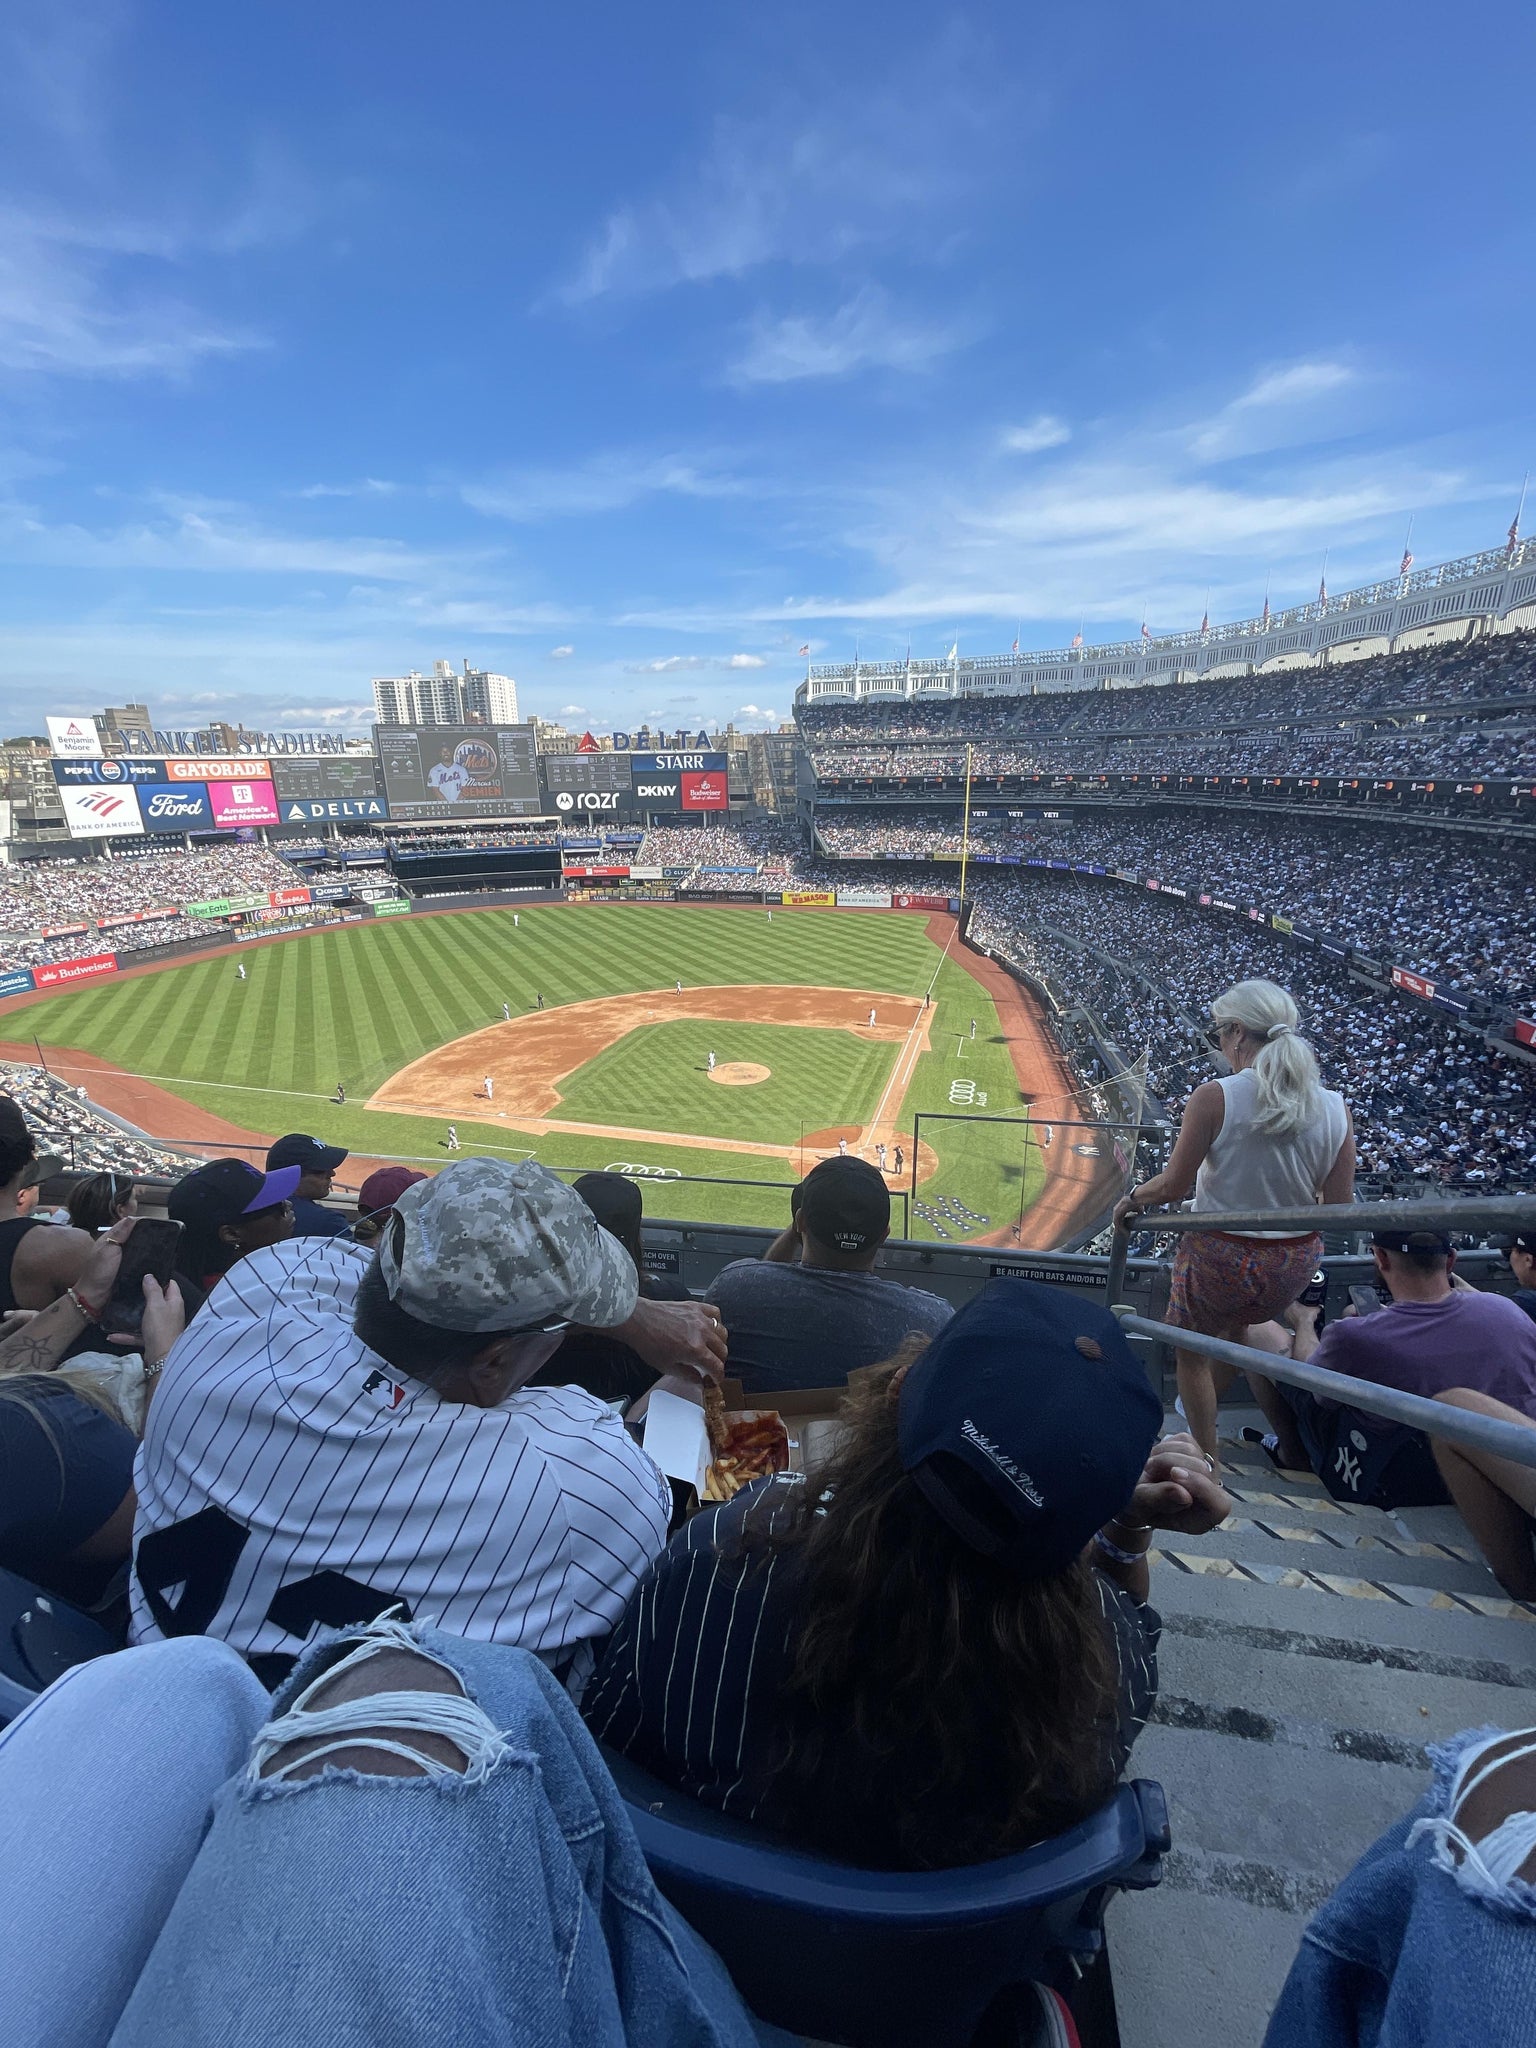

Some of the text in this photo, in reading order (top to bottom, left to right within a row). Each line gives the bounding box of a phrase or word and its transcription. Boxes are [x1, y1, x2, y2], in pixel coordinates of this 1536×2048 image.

[57, 736, 95, 746] Benjamin
[117, 729, 347, 755] YANKEE STADIUM
[613, 730, 714, 750] DELTA
[64, 744, 91, 752] Moore
[465, 754, 489, 768] Mets
[655, 755, 704, 769] STARR
[173, 762, 267, 777] GATORADE
[462, 787, 502, 796] SEMIEN
[637, 785, 677, 797] DKNY
[148, 793, 203, 816] Ford
[577, 793, 620, 809] razr
[223, 806, 268, 814] America's
[311, 801, 381, 817] DELTA
[216, 812, 278, 822] Best Network
[209, 903, 229, 913] Eats
[59, 961, 114, 978] Budweiser
[834, 1232, 867, 1243] NEW YORK
[996, 1267, 1006, 1276] BE
[1007, 1268, 1030, 1278] ALERT
[1030, 1270, 1044, 1279] FOR
[1046, 1272, 1065, 1281] BATS
[1066, 1274, 1095, 1283] AND/OR
[961, 1419, 1013, 1467] Mitchell
[1016, 1472, 1045, 1502] Ness
